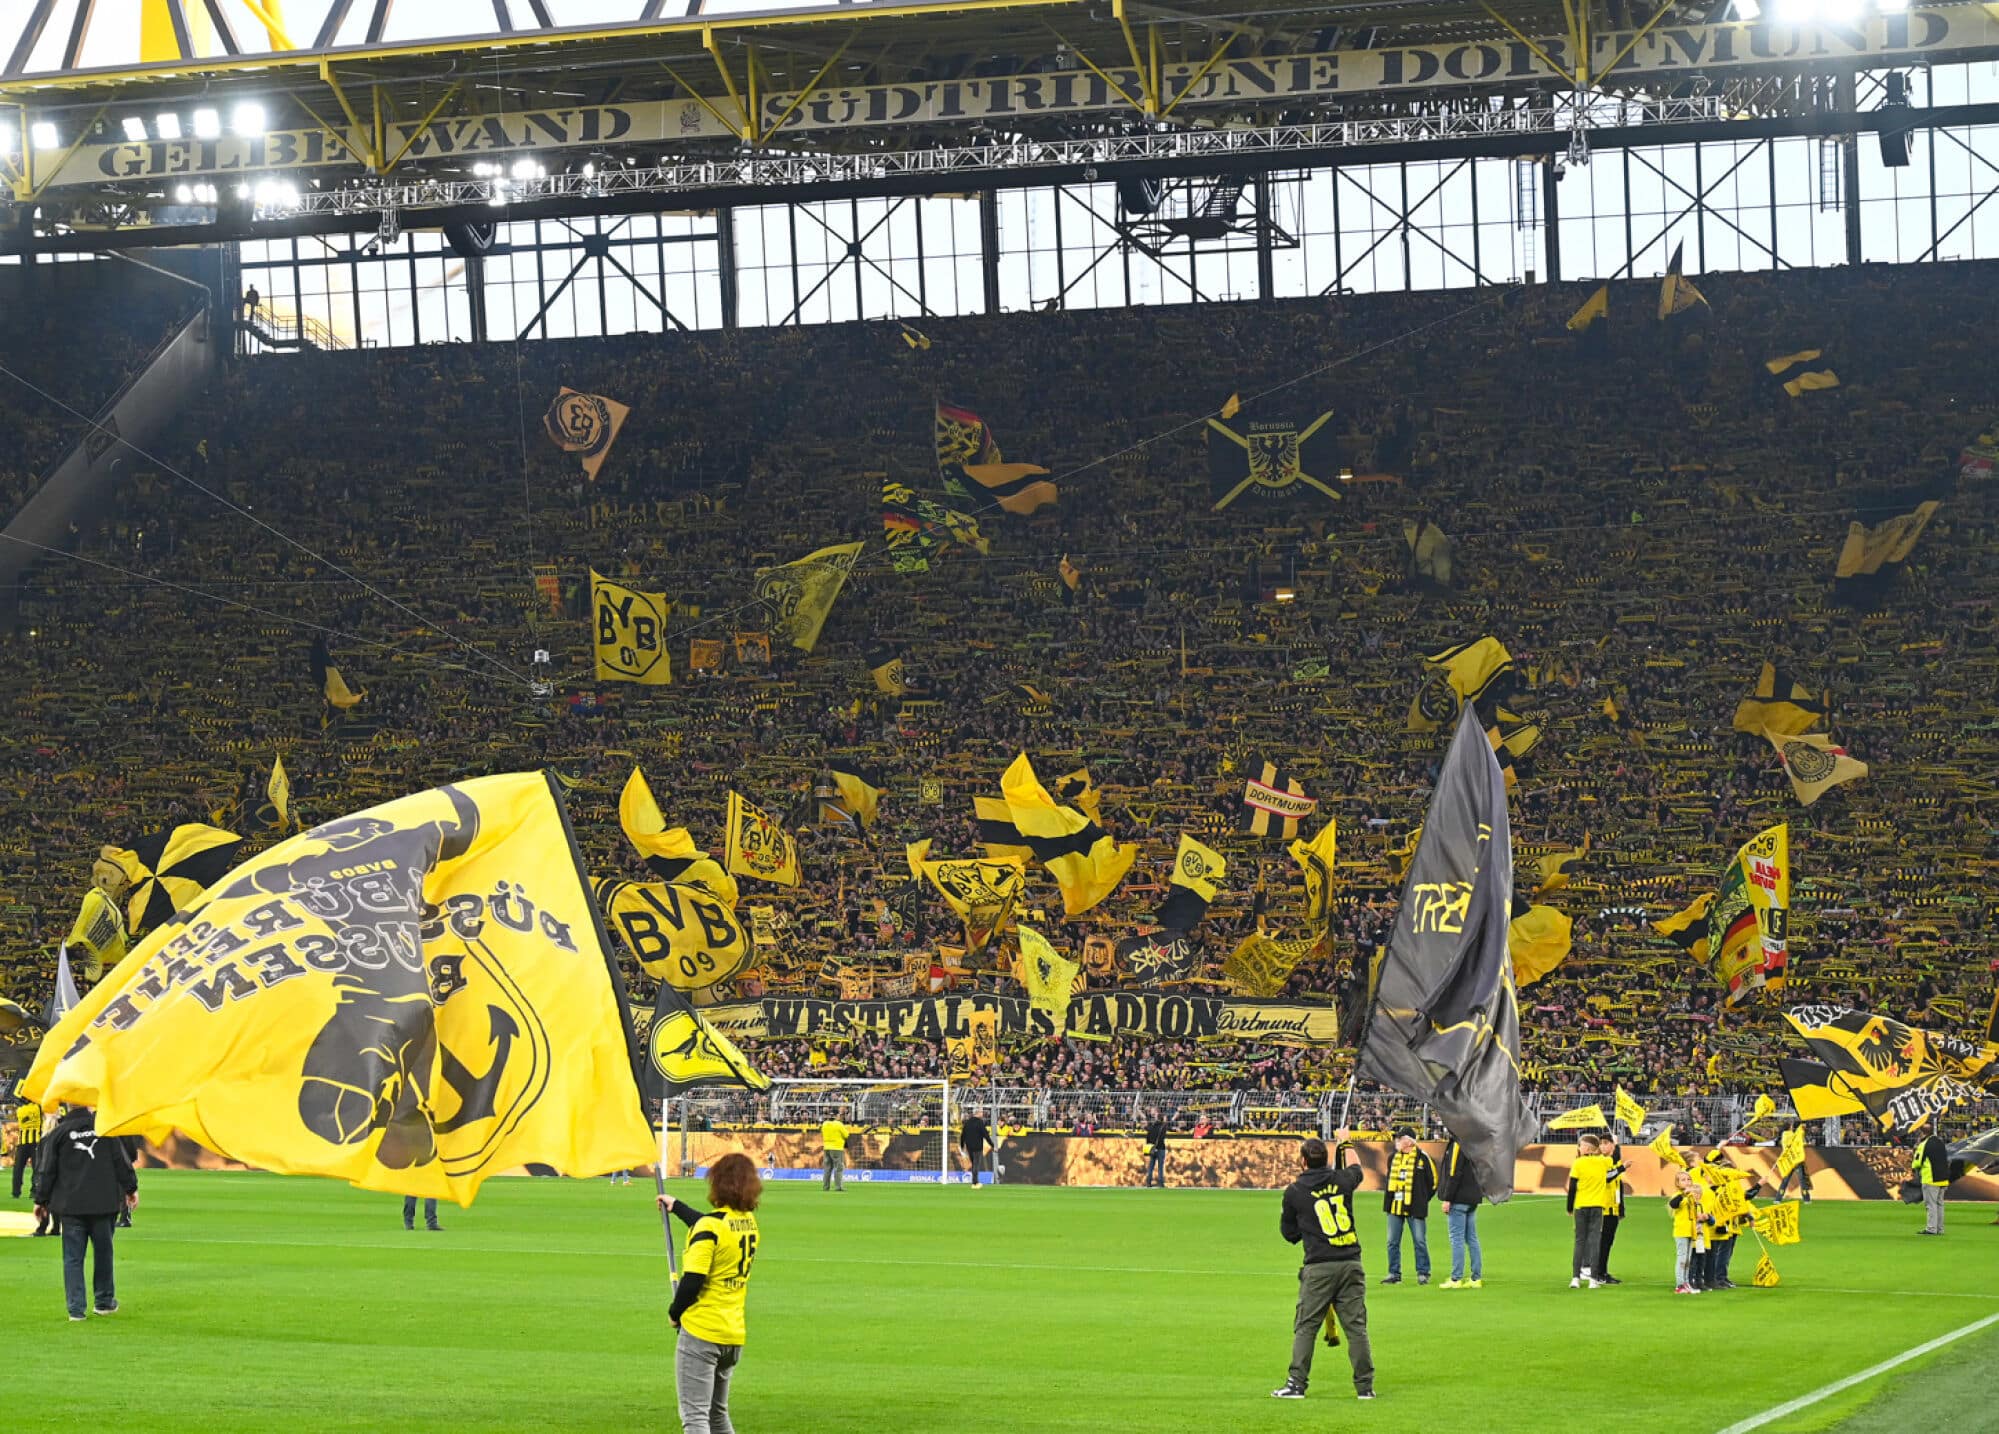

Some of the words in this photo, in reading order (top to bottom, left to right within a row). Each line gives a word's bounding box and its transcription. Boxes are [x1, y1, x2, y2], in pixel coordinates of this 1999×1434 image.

[98, 127, 349, 179] GELBE
[393, 107, 632, 155] WAND
[764, 55, 1340, 130] SÜDTRIBÜNE
[1379, 12, 1949, 86] DORTMUND
[1250, 421, 1295, 432] Borussia
[598, 589, 657, 651] BVB
[1249, 788, 1312, 812] DORTMUND
[618, 886, 737, 964] BVB
[679, 951, 716, 978] 09
[1217, 1010, 1312, 1032] Dortmund
